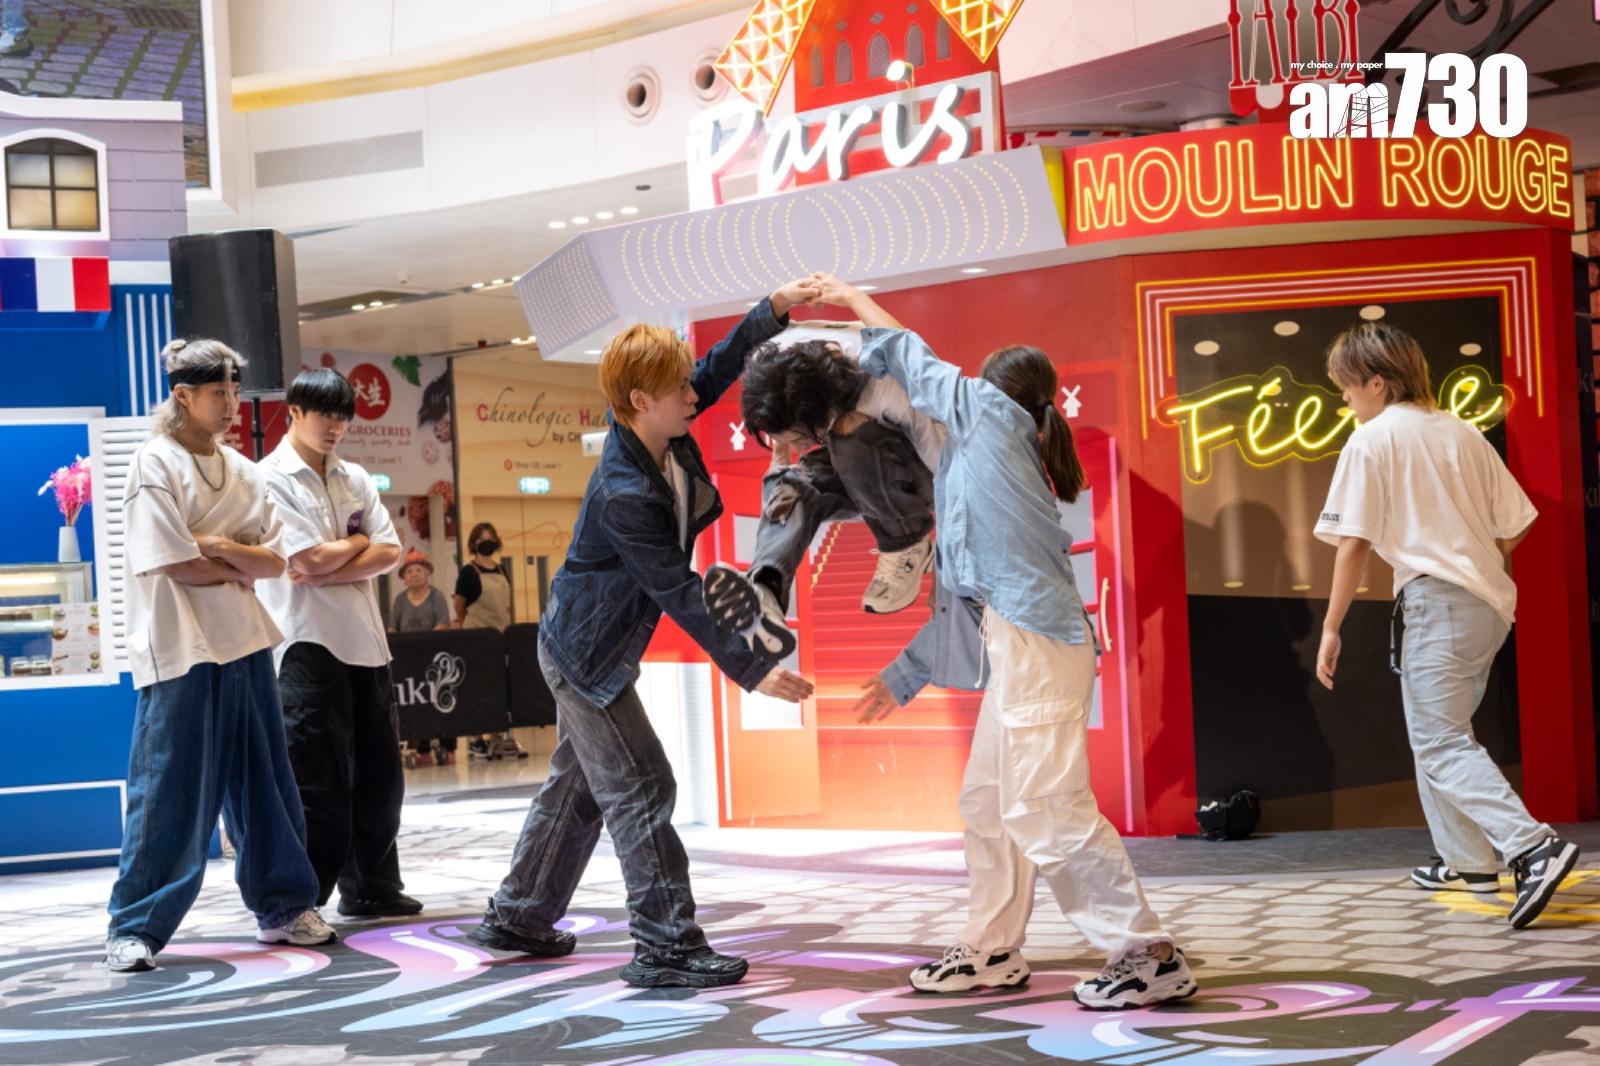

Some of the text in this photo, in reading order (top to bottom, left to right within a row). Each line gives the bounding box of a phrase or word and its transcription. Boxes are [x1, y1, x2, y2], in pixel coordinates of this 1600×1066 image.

[687, 60, 969, 210] Paris
[1073, 136, 1571, 232] MOULIN ROUGE
[348, 425, 411, 437] GROCERIES
[476, 386, 571, 447] Chinologic
